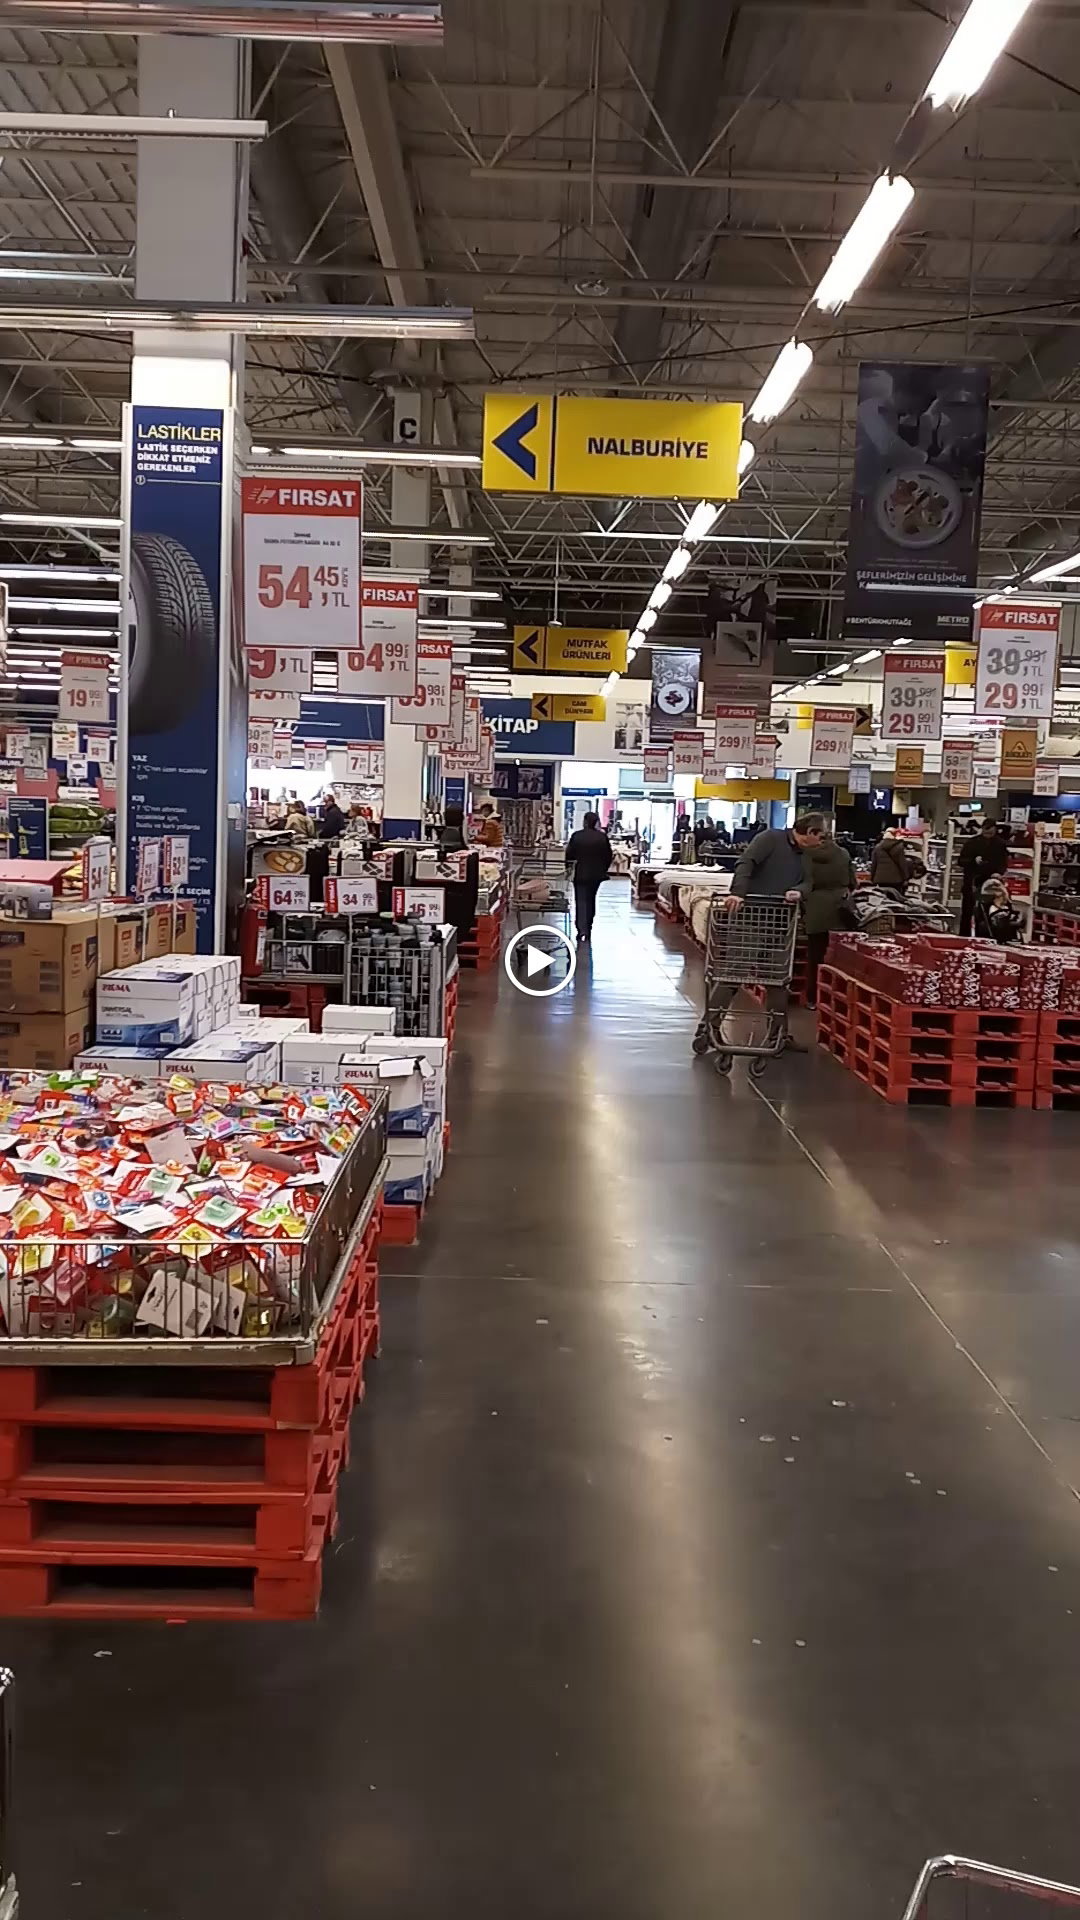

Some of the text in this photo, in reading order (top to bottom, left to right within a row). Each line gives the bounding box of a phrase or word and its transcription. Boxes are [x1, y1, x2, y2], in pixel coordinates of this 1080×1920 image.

[138, 422, 221, 441] LASTİKLER
[400, 418, 417, 439] C
[137, 442, 218, 454] LASTİK SEÇERKEN
[587, 437, 709, 459] NALBURİYE
[137, 452, 211, 464] DİKKAT ETMENİZ
[137, 463, 196, 473] GEREKENLER
[279, 488, 356, 507] FIRSAT
[258, 564, 312, 608] 54
[313, 565, 339, 587] 45
[363, 589, 416, 602] FIRSAT
[937, 615, 969, 624] METRO
[1004, 612, 1057, 625] FIRSAT
[385, 643, 403, 657] 99
[567, 639, 608, 648] MUTFAK
[903, 659, 943, 669] FIRSAT
[986, 648, 1020, 675] 39
[67, 689, 87, 707] 19
[890, 687, 917, 707] 39
[984, 682, 1018, 709] 29
[1022, 683, 1038, 696] 99
[485, 715, 539, 733] KİTAP
[888, 713, 915, 734] 29
[719, 736, 739, 748] 299
[815, 740, 837, 752] 299
[274, 890, 293, 905] 64
[342, 894, 358, 905] 34
